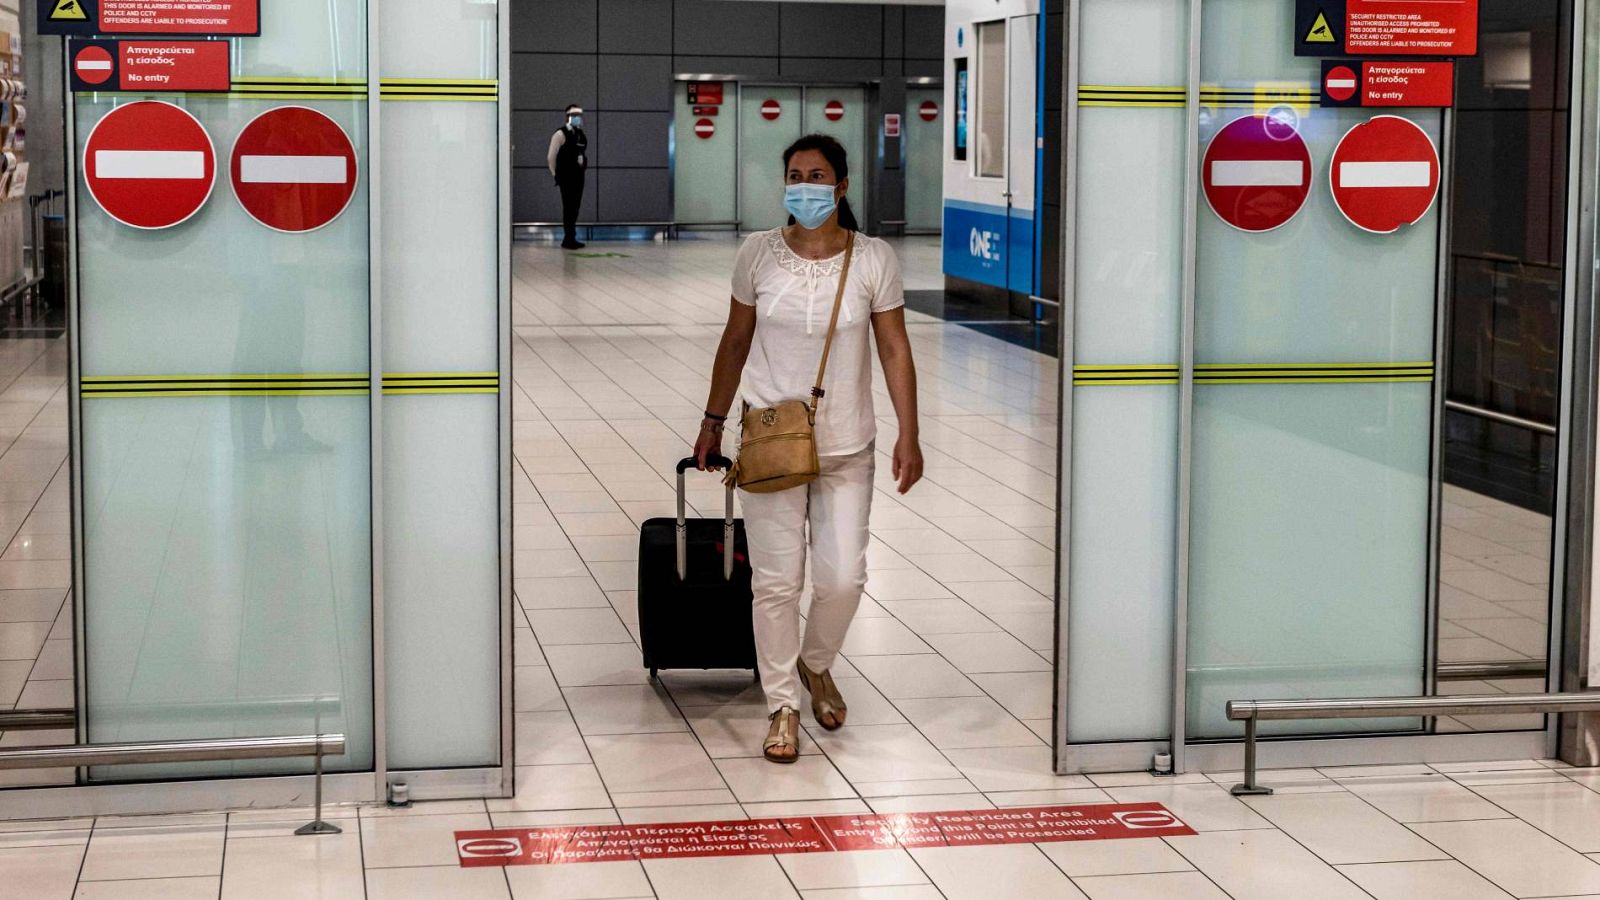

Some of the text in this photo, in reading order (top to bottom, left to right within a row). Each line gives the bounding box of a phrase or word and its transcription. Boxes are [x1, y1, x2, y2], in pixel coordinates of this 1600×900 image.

[127, 46, 195, 55] Απαγορεύεται
[127, 56, 175, 66] η είσοδος
[1369, 66, 1425, 75] Απαγορεύεται
[144, 74, 169, 83] entry
[1369, 75, 1409, 85] η είσοδος
[1369, 91, 1403, 100] No entry
[636, 826, 706, 834] Περιοχή
[834, 829, 876, 837] Entry
[943, 823, 973, 831] this
[976, 822, 1017, 830] Point
[1018, 821, 1035, 829] is
[1037, 816, 1117, 827] Prohibited
[689, 836, 700, 844] η
[953, 832, 982, 841] will
[983, 831, 1005, 840] be
[643, 844, 663, 854] θα
